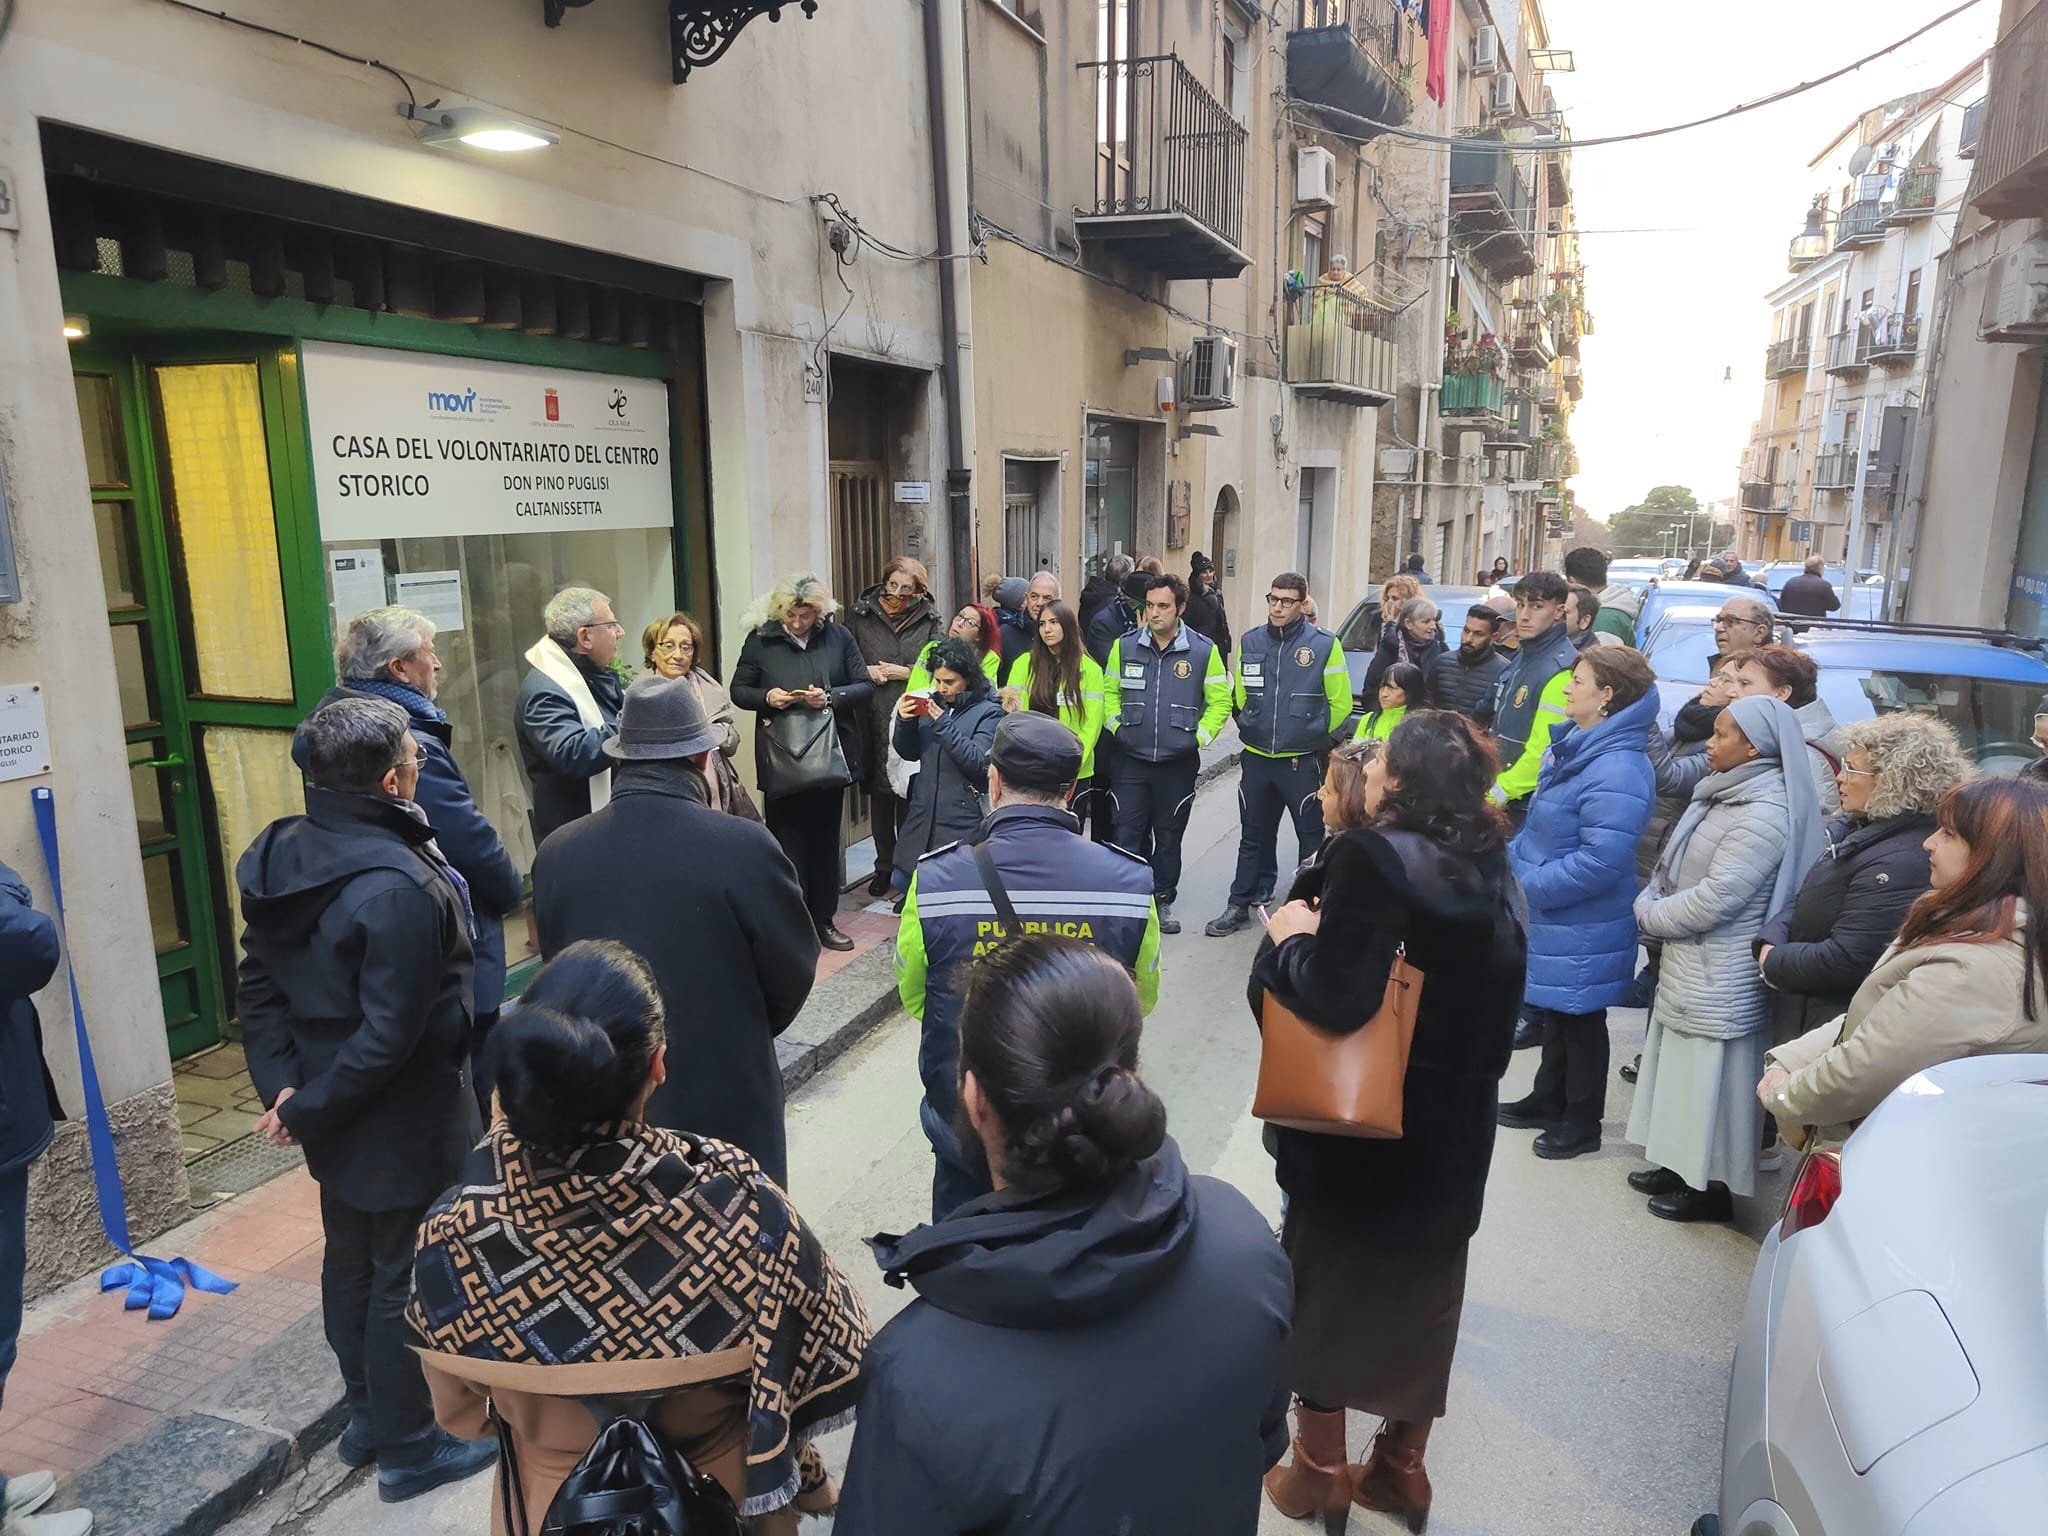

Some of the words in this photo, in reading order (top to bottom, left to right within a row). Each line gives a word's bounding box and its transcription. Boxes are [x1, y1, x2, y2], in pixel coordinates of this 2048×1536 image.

[806, 379, 820, 395] 240
[428, 387, 477, 413] movi
[332, 435, 390, 459] CASA
[396, 437, 433, 460] DEL
[438, 439, 570, 463] VOLONTARIATO
[575, 444, 601, 464] DEL
[605, 445, 659, 466] CENTRO
[338, 474, 430, 497] STORICO
[503, 475, 532, 490] DON
[535, 476, 564, 490] PINO
[568, 476, 610, 491] PUGLISI
[516, 501, 603, 517] CALTANISSETTA
